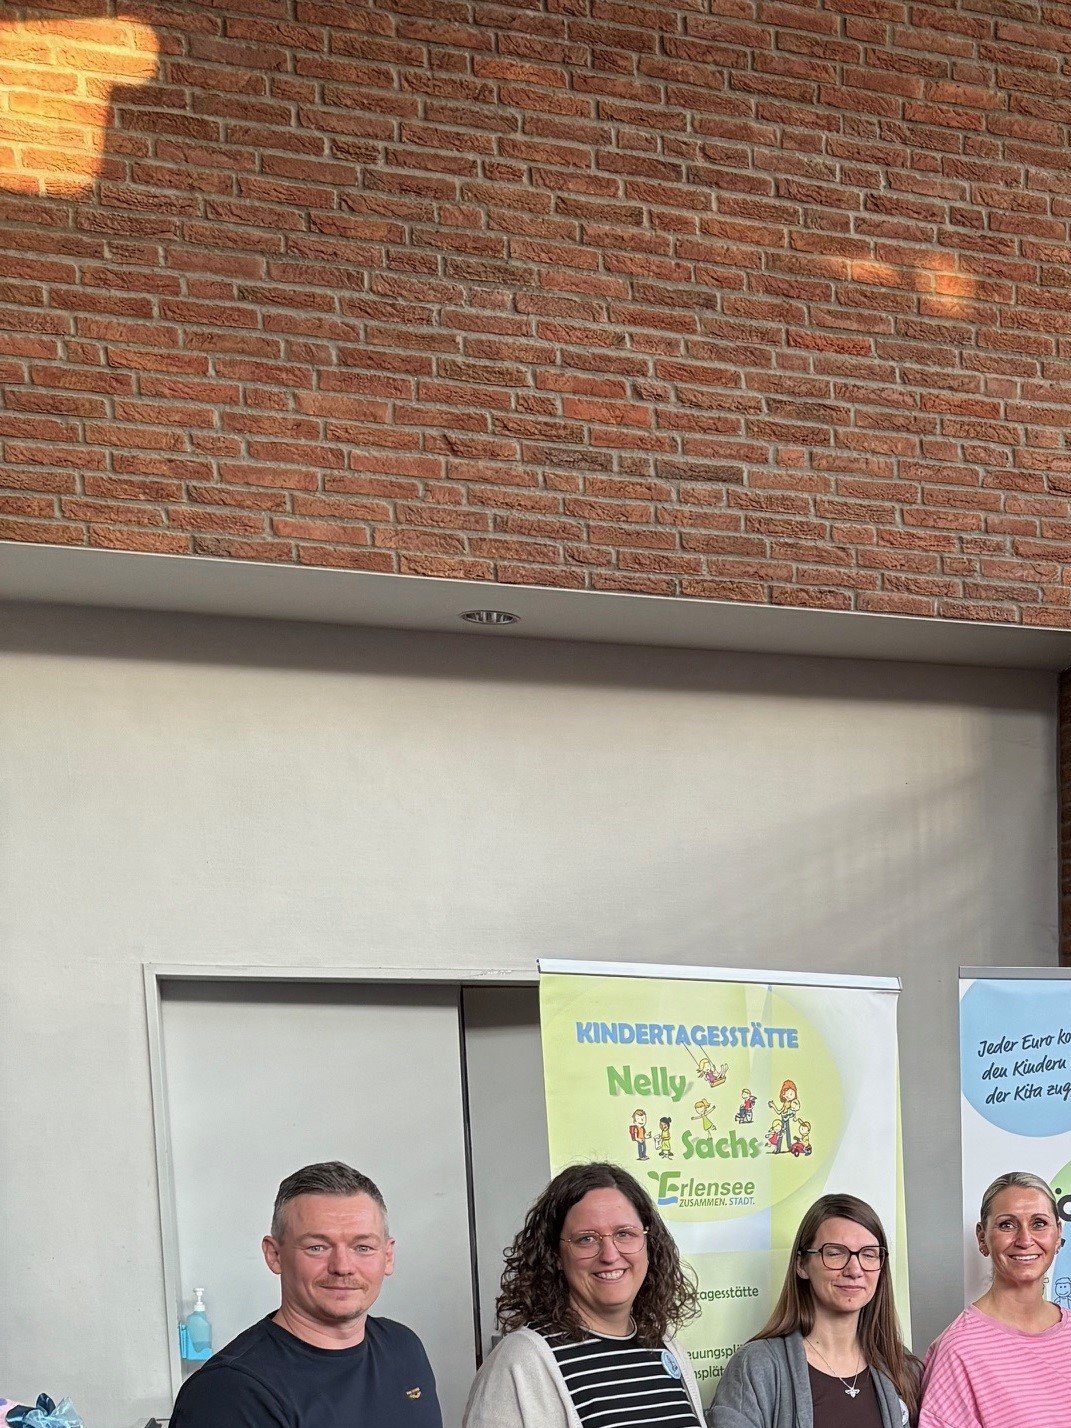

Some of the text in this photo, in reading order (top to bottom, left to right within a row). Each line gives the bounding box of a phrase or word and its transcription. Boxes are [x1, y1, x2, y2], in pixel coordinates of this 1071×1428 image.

[576, 1021, 799, 1049] KINDERTAGESSTÄTTE
[978, 1036, 1018, 1057] Jeder
[1022, 1034, 1055, 1050] Euro
[982, 1062, 1008, 1080] den
[1013, 1054, 1067, 1076] Kindern
[606, 1065, 687, 1103] Nelly
[985, 1086, 1011, 1104] der
[1014, 1083, 1043, 1101] Kita
[681, 1129, 760, 1160] Sachs
[648, 1171, 756, 1198] Erlensee
[679, 1196, 755, 1208] ZUSAMMEN. STADT.
[695, 1286, 759, 1301] tagesstätte
